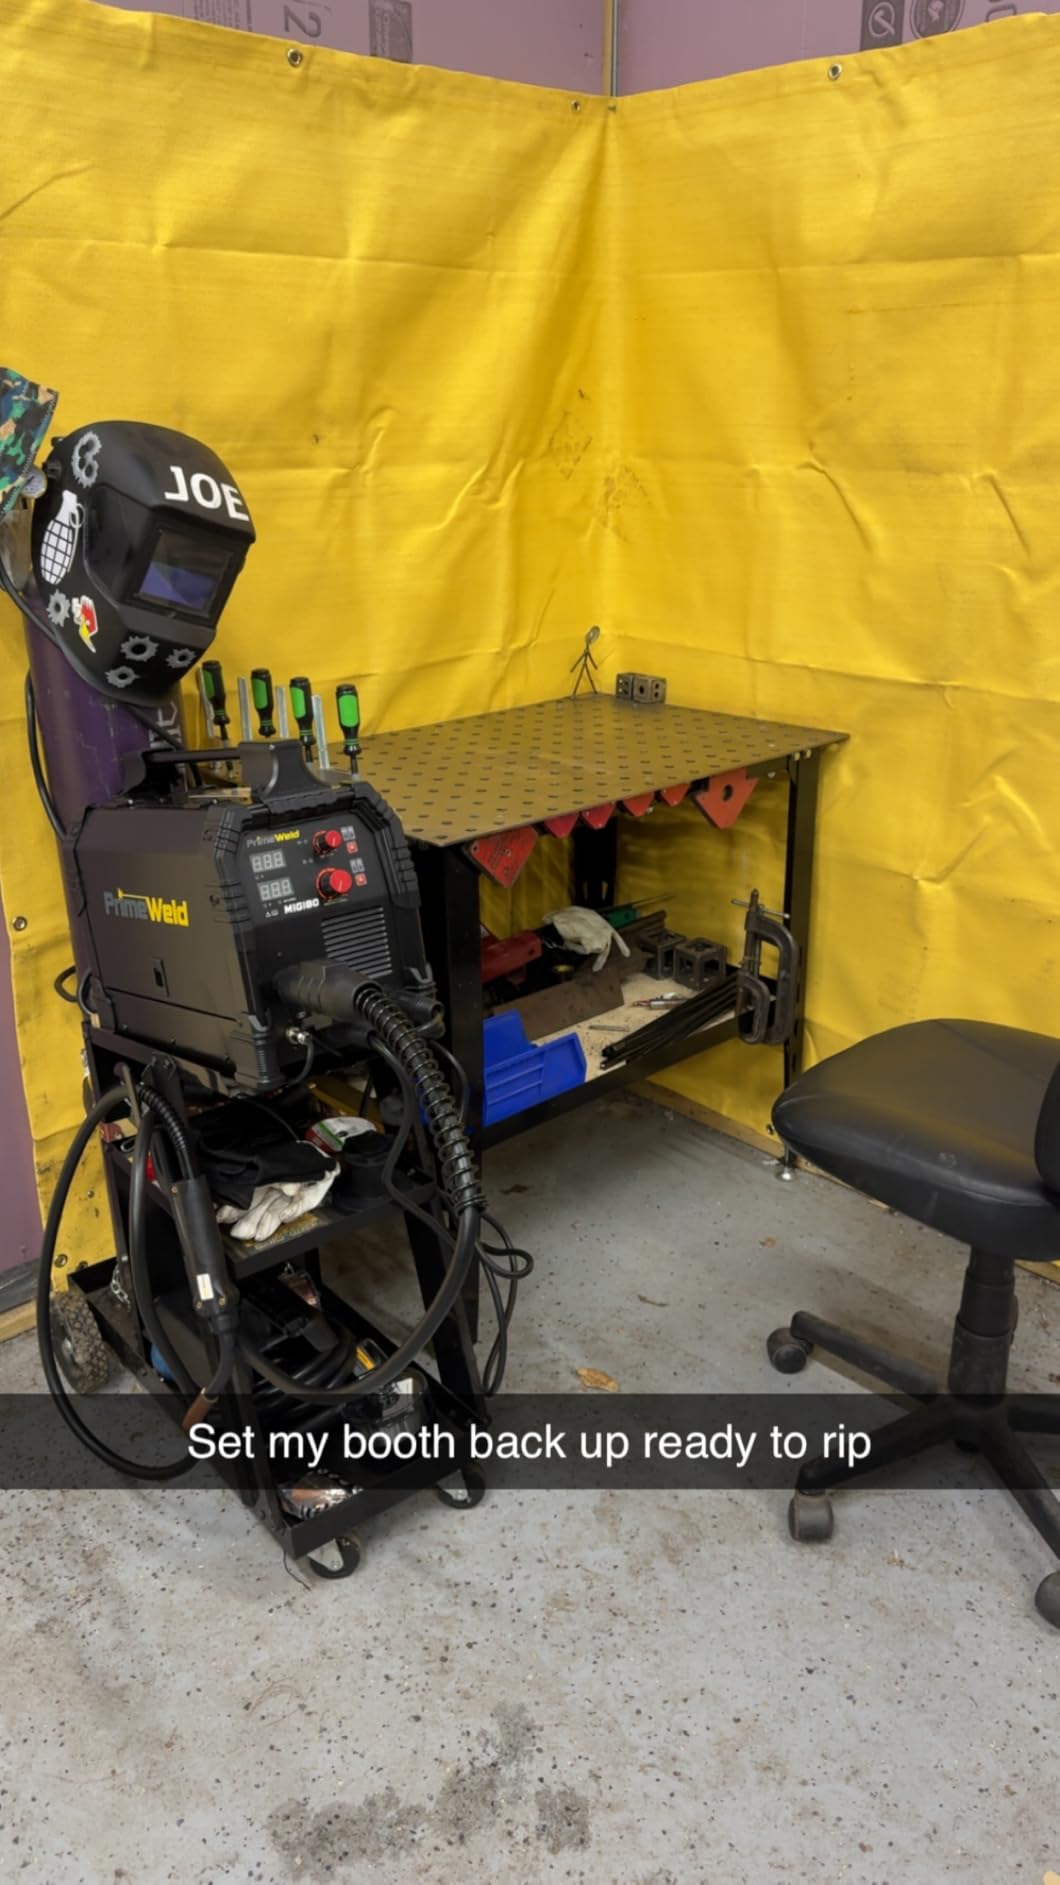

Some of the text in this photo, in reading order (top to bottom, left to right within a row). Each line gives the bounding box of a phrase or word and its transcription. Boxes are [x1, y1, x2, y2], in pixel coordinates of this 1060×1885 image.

[164, 465, 250, 522] JOE
[246, 829, 300, 848] PrimeWeld
[104, 888, 189, 927] PrimeWeld
